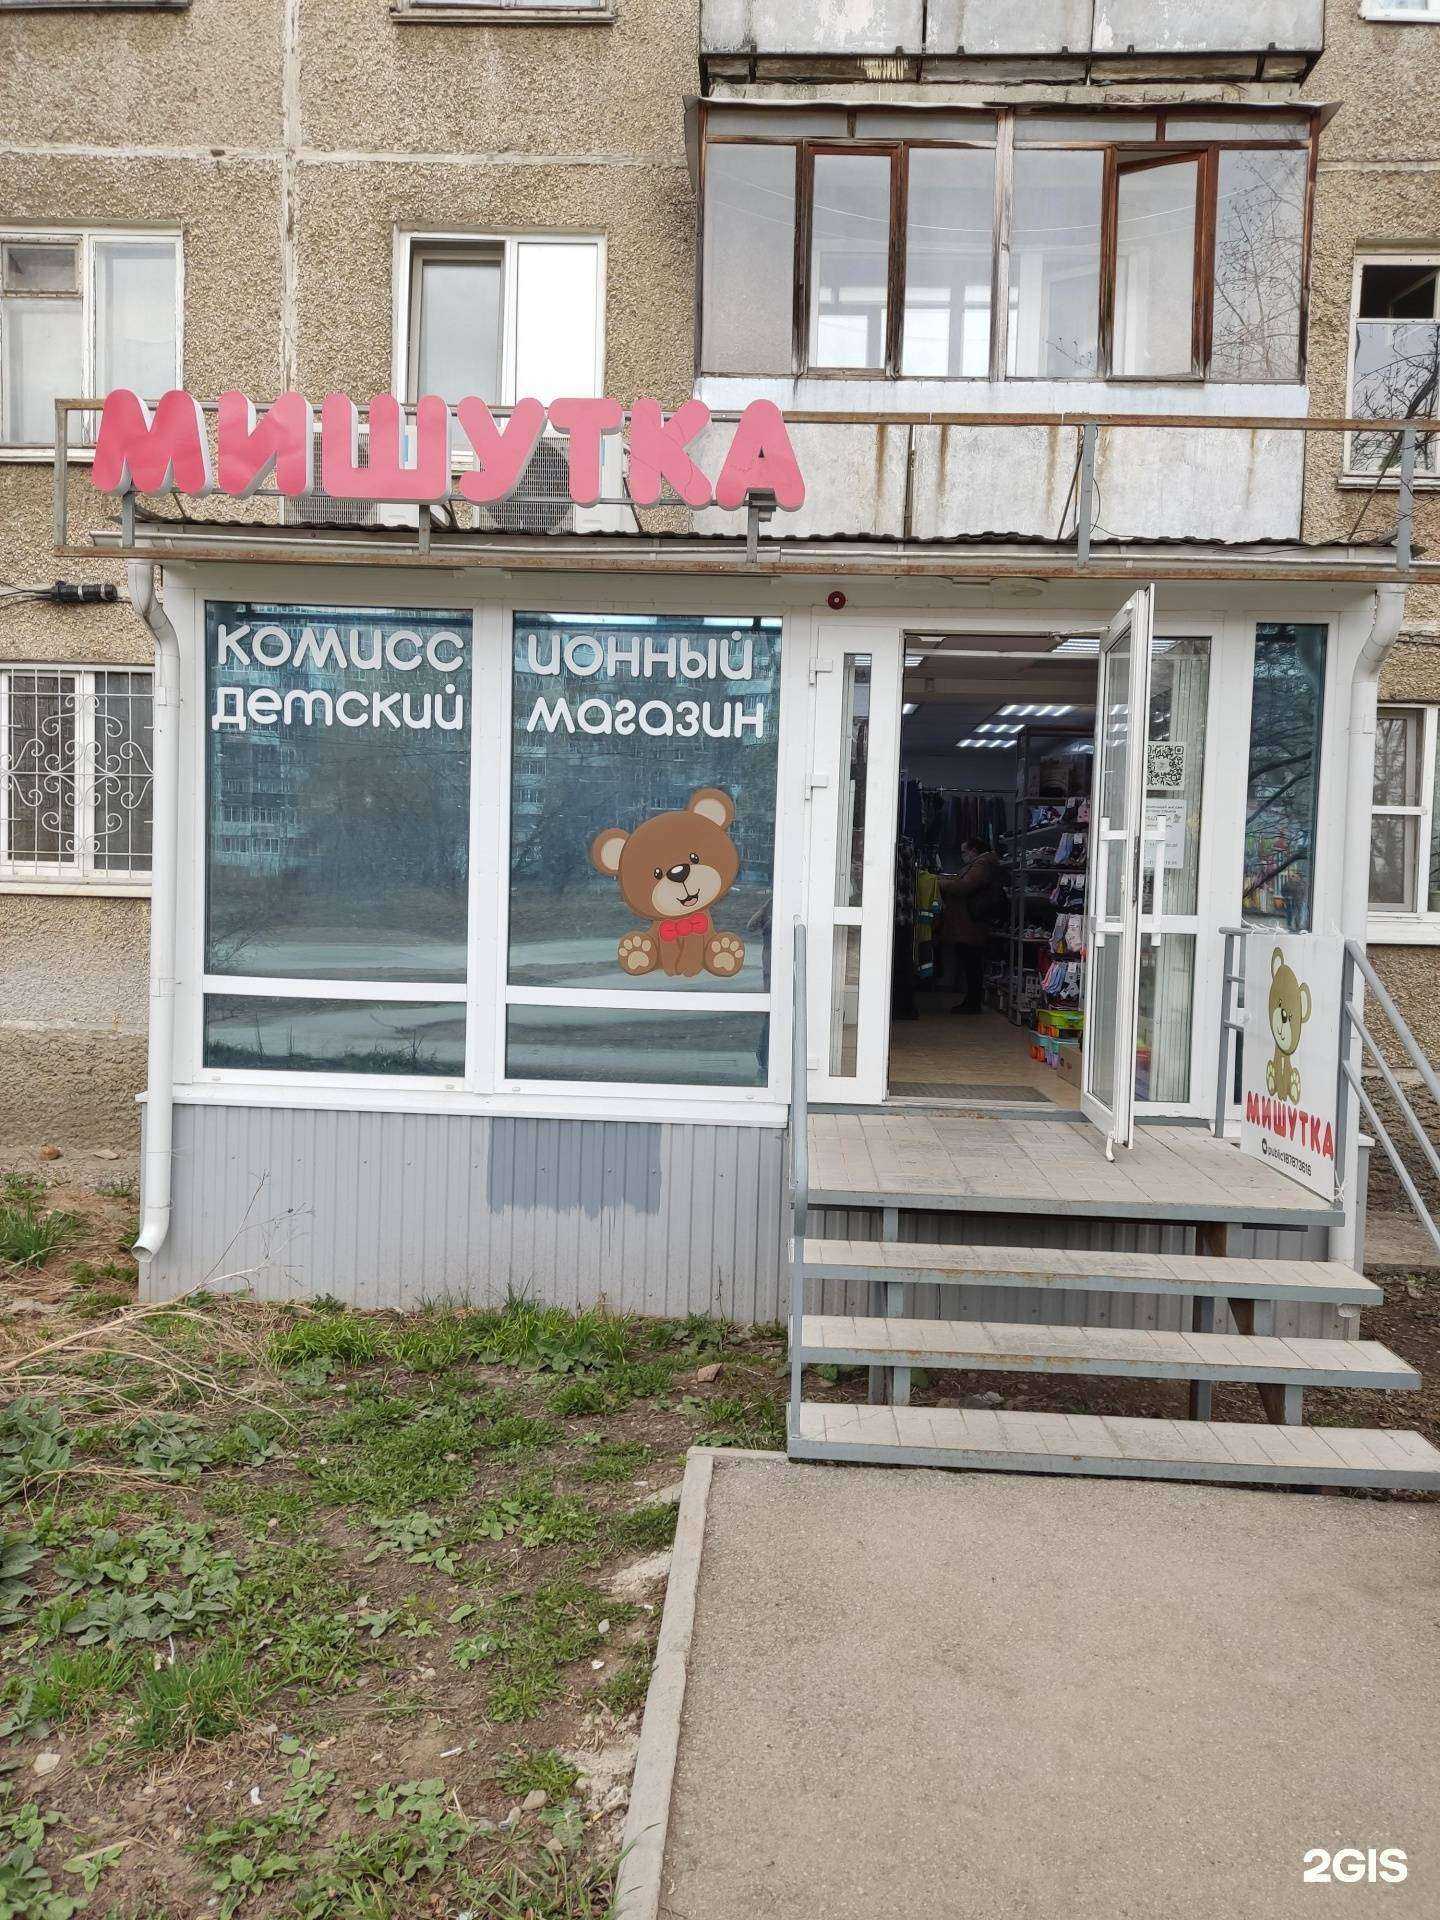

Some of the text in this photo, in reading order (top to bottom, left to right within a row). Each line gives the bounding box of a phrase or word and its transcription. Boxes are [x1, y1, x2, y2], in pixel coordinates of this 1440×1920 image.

[91, 389, 806, 512] МИШУТКА
[526, 697, 764, 738] магазин
[1246, 1090, 1334, 1161] МИШУТКА
